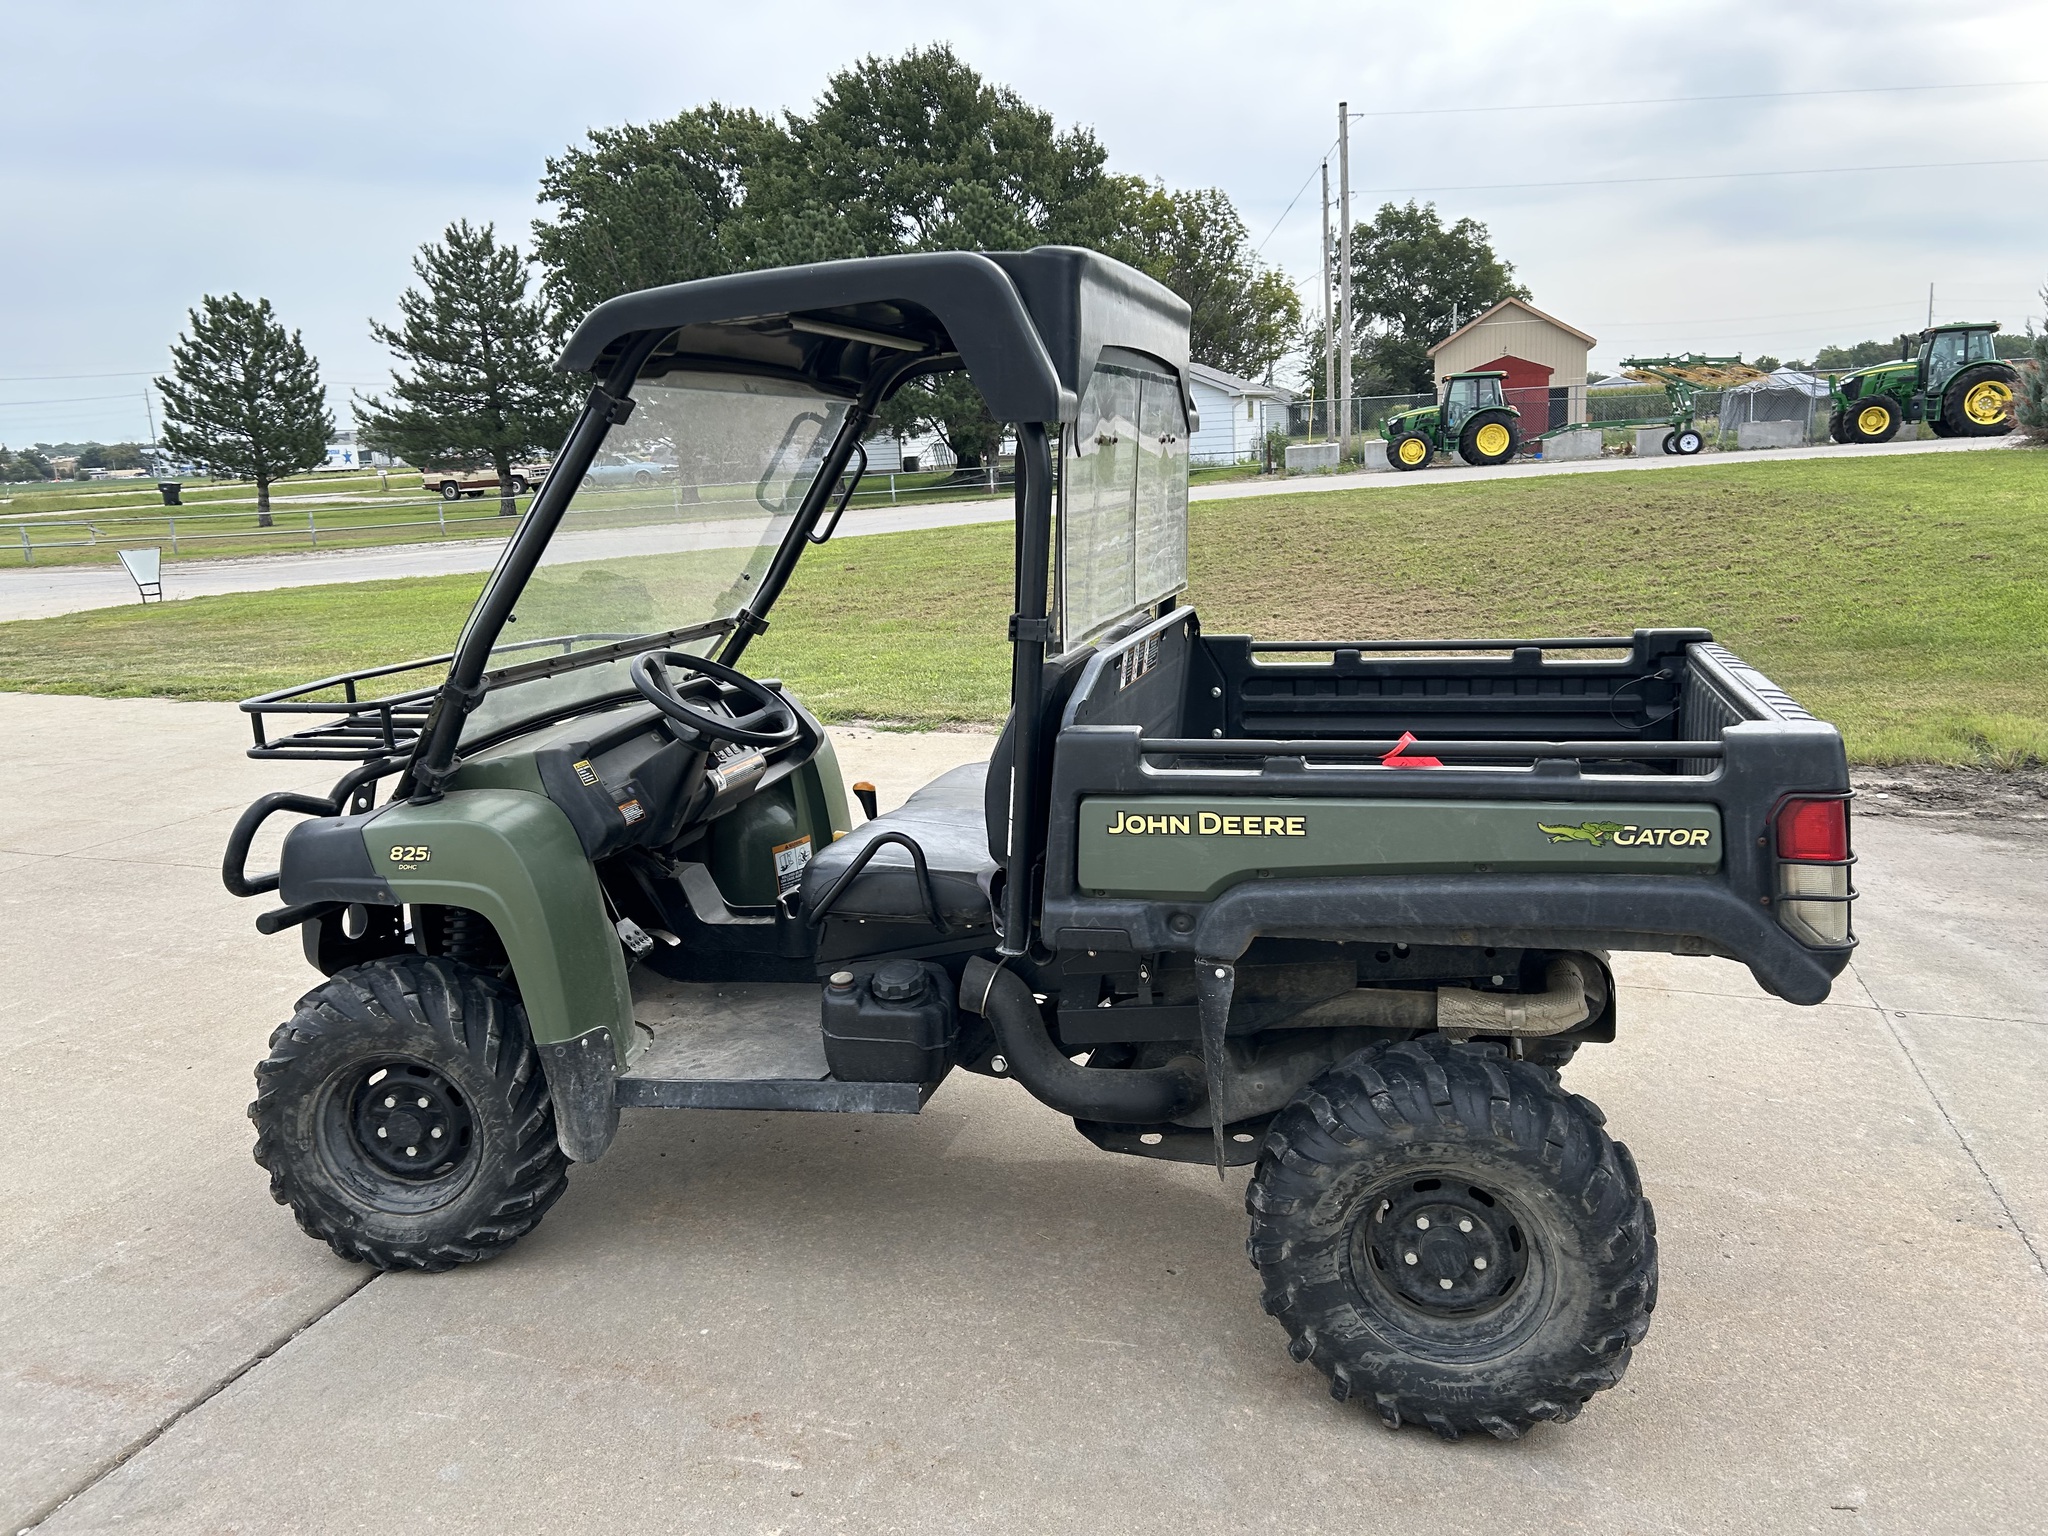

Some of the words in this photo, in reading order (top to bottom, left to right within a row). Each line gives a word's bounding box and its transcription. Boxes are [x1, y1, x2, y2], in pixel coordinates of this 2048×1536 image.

[1108, 811, 1191, 835] JOHN
[1198, 811, 1306, 836] DEERE
[1613, 825, 1710, 846] GATOR
[389, 846, 432, 861] 825i
